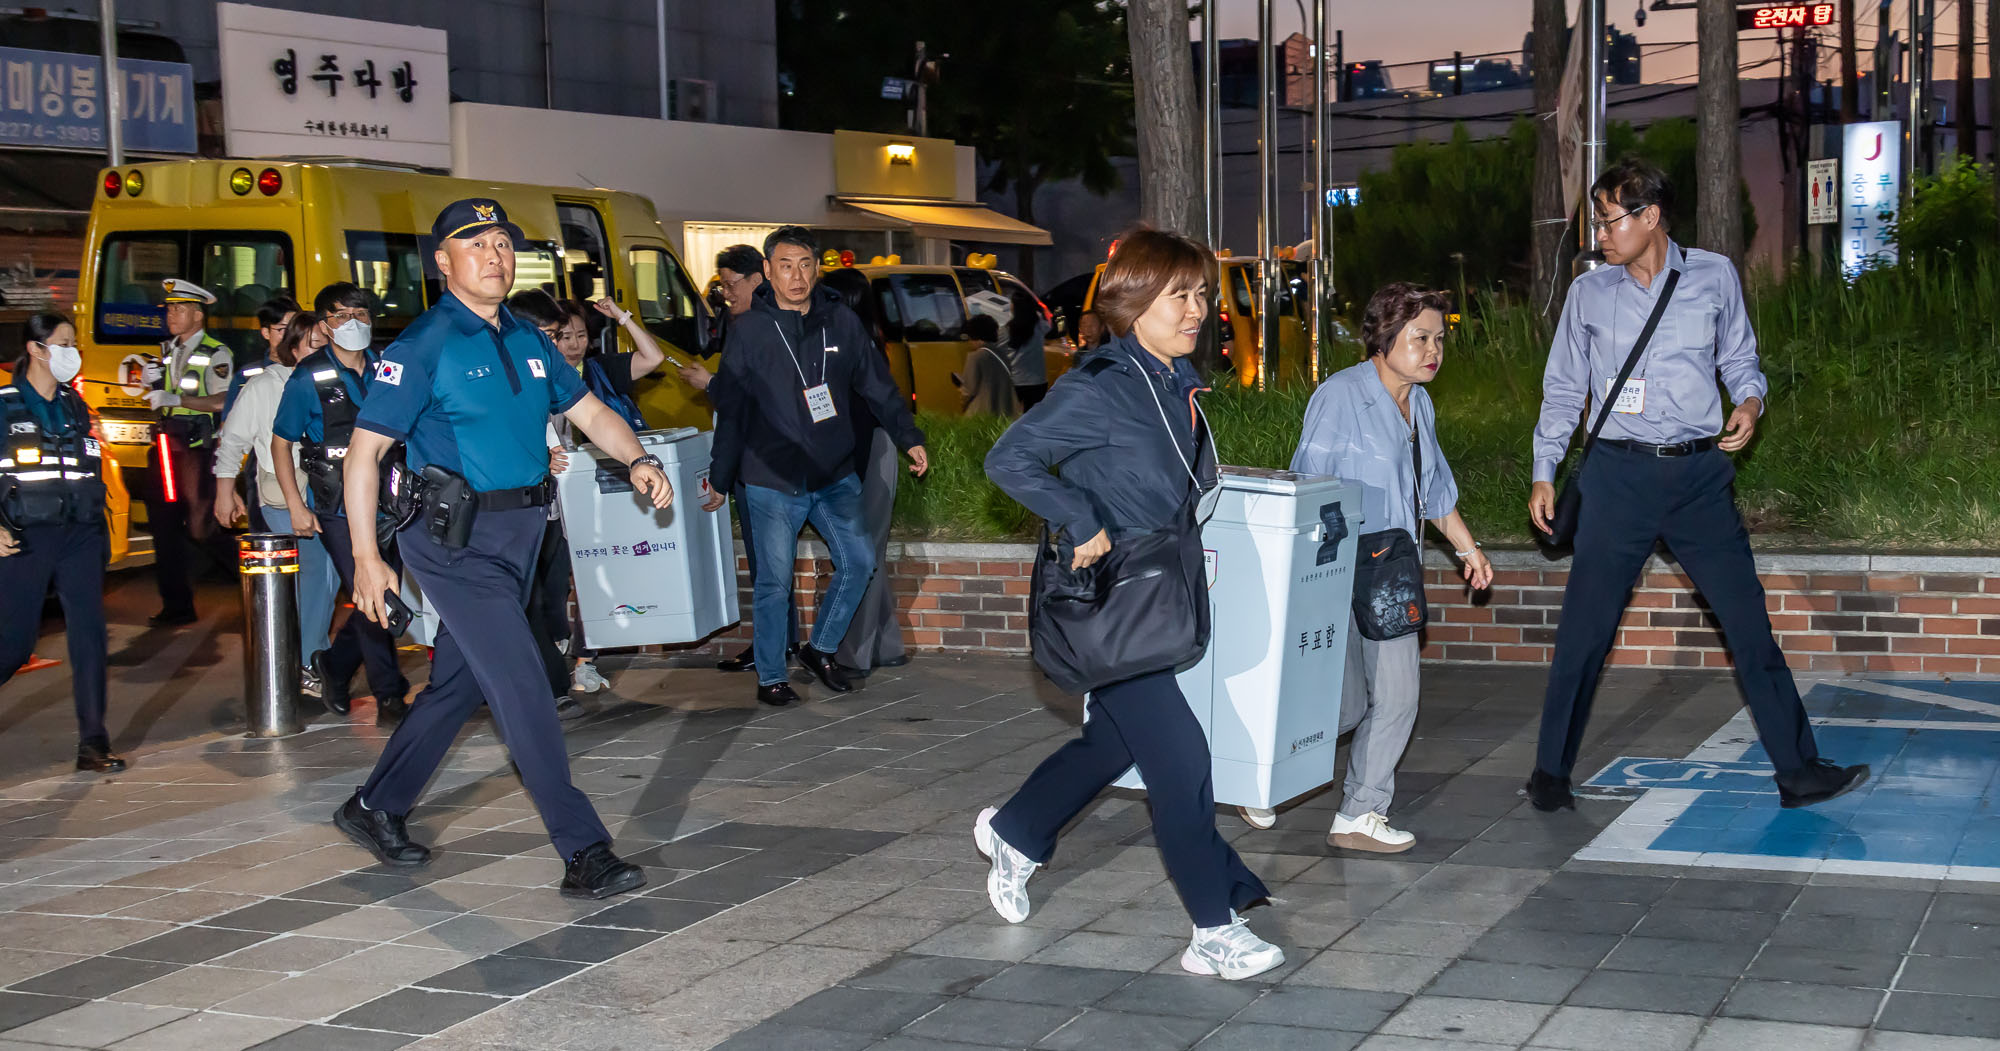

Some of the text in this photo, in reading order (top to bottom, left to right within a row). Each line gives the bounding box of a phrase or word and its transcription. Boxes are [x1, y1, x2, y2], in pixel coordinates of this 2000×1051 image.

[1754, 4, 1833, 28] 운전자 탑
[0, 61, 184, 124] 미싱봉기계
[273, 48, 419, 103] 영주다방
[1850, 173, 1868, 270] 중구구민
[575, 547, 608, 559] 민주주의
[611, 545, 629, 556] 꽃은
[1298, 623, 1336, 657] 투표함
